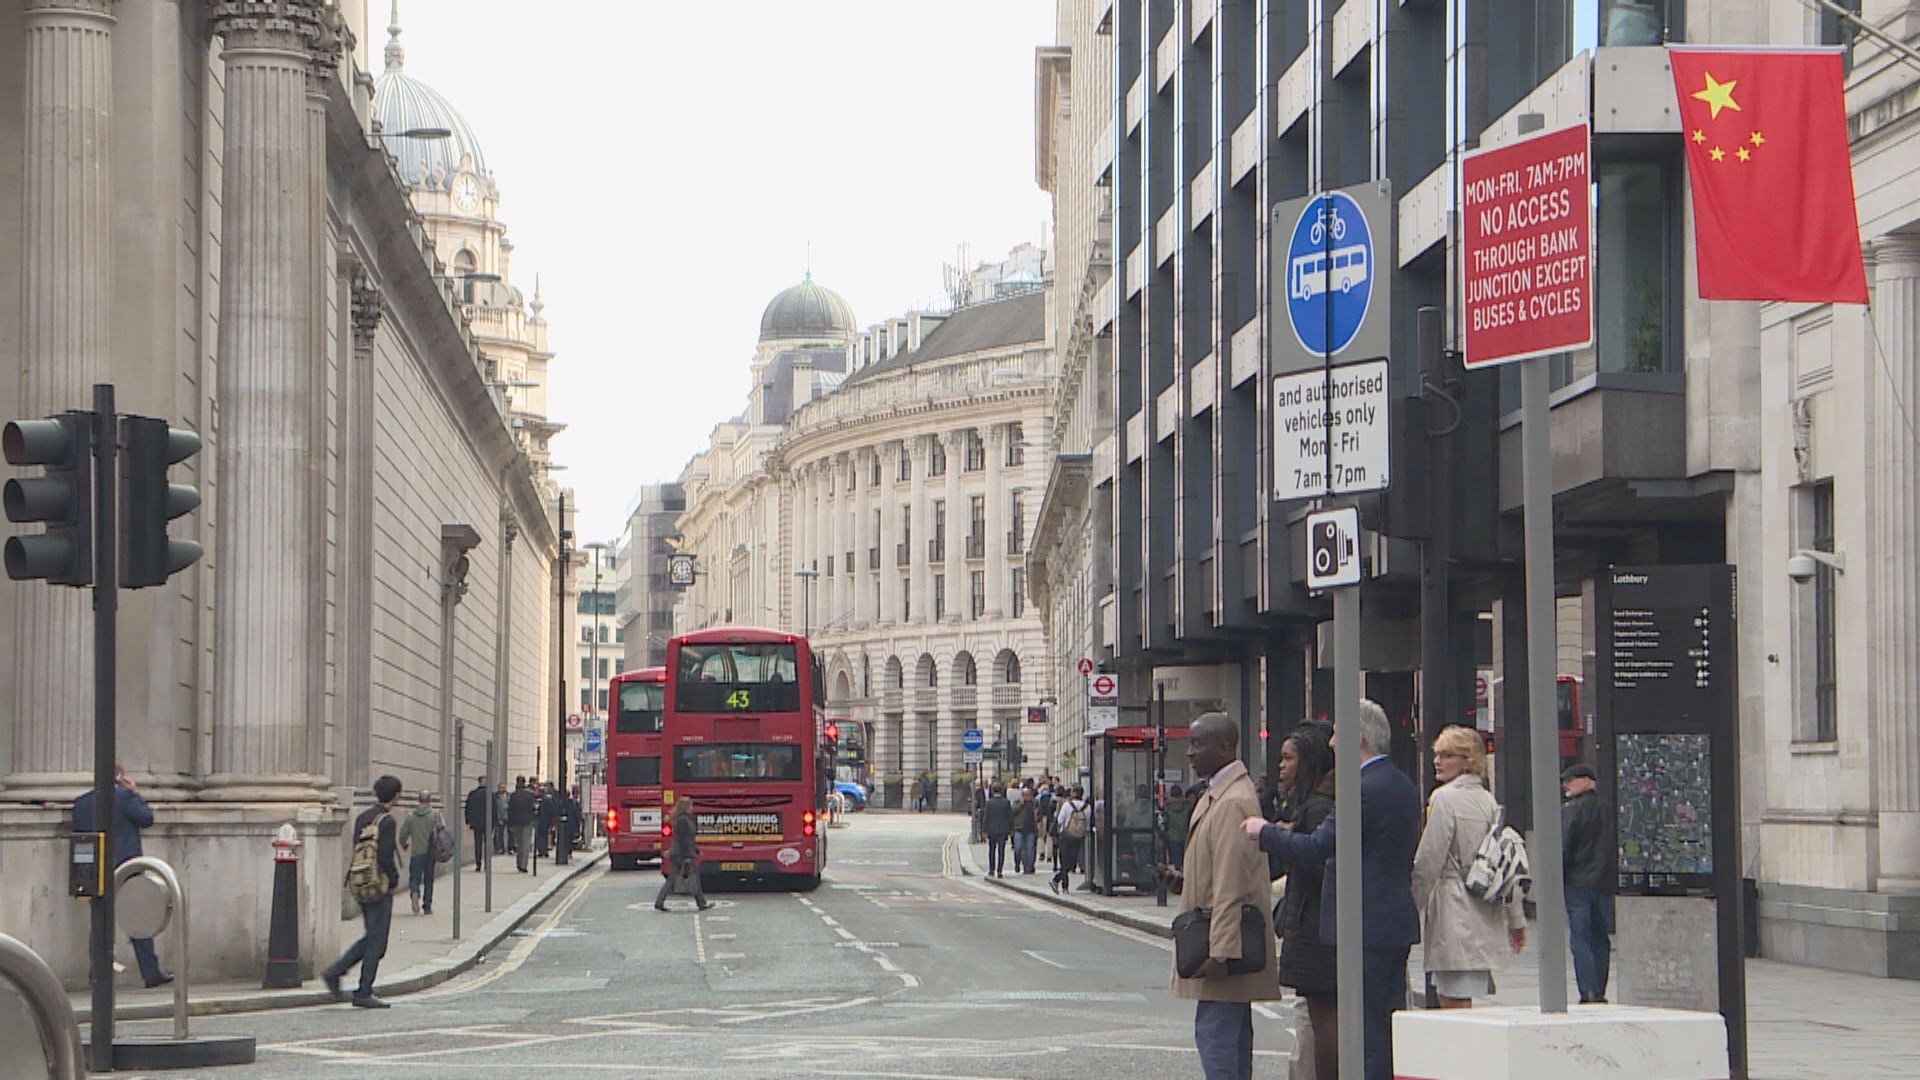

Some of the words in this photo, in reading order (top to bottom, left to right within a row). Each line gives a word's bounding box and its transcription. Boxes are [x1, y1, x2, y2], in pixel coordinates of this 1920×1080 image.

[1526, 152, 1585, 190] 7AM-7PM
[1480, 206, 1503, 238] NO
[1507, 188, 1570, 231] ACCESS
[1473, 237, 1536, 273] THROUGH
[1540, 226, 1578, 258] BANK
[1468, 267, 1532, 304] JUNCTION
[1536, 255, 1586, 289] EXCEPT
[1473, 301, 1515, 332] BUSES
[1518, 298, 1527, 321] &
[1530, 287, 1581, 320] CYCLES
[1279, 384, 1302, 407] and
[1305, 371, 1382, 403] authorised
[1285, 408, 1341, 433] vehicles
[1346, 402, 1375, 426] only
[1300, 437, 1328, 458] Mon
[1342, 431, 1360, 453] Fri
[1294, 469, 1322, 489] 7am
[1335, 464, 1366, 487] 7pm
[1613, 574, 1648, 584] Lothbury
[1080, 659, 1090, 672] A
[727, 690, 750, 708] 43
[697, 815, 715, 824] BUS
[716, 814, 778, 824] ADVERTISING
[723, 824, 778, 833] NORWICH
